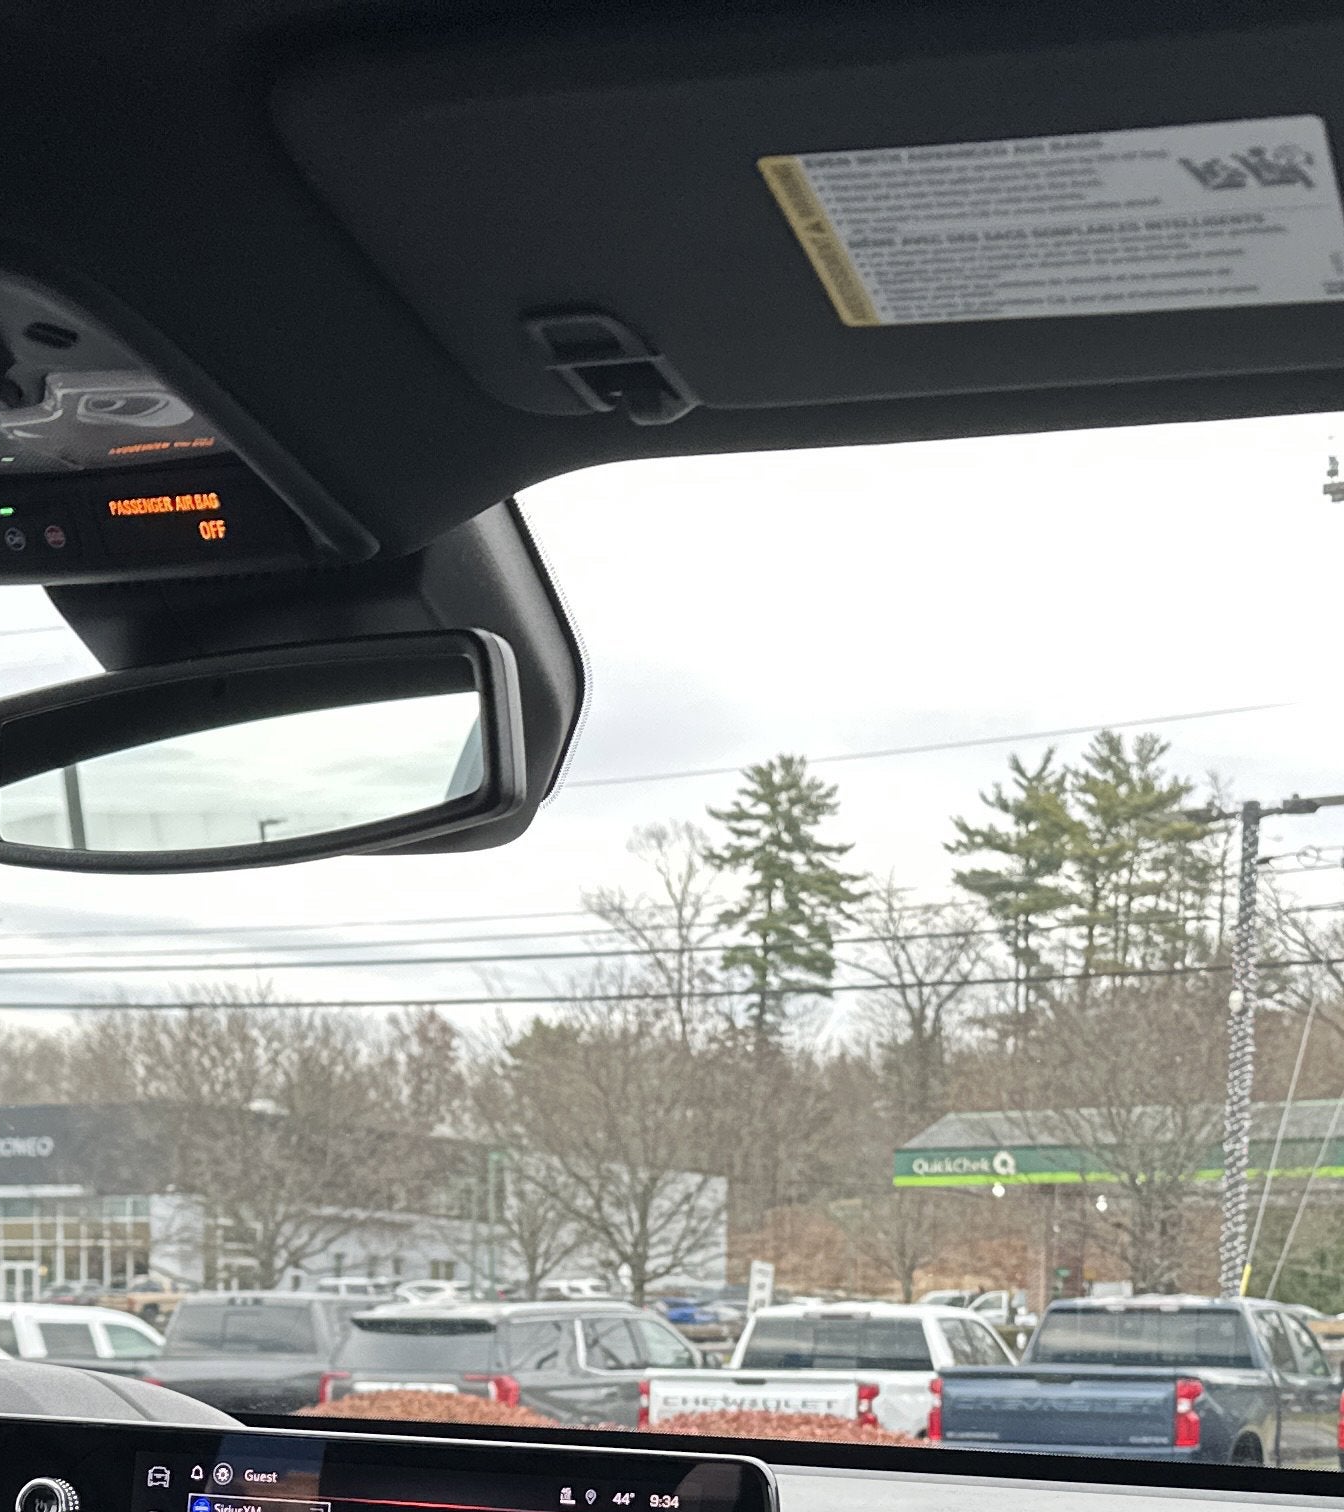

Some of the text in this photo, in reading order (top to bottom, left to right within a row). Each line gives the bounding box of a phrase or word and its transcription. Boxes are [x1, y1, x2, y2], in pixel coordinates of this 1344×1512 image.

[109, 496, 173, 516] PASSENGER
[199, 520, 226, 540] OFF
[244, 1468, 278, 1484] Guest
[649, 1494, 680, 1509] 9:34
